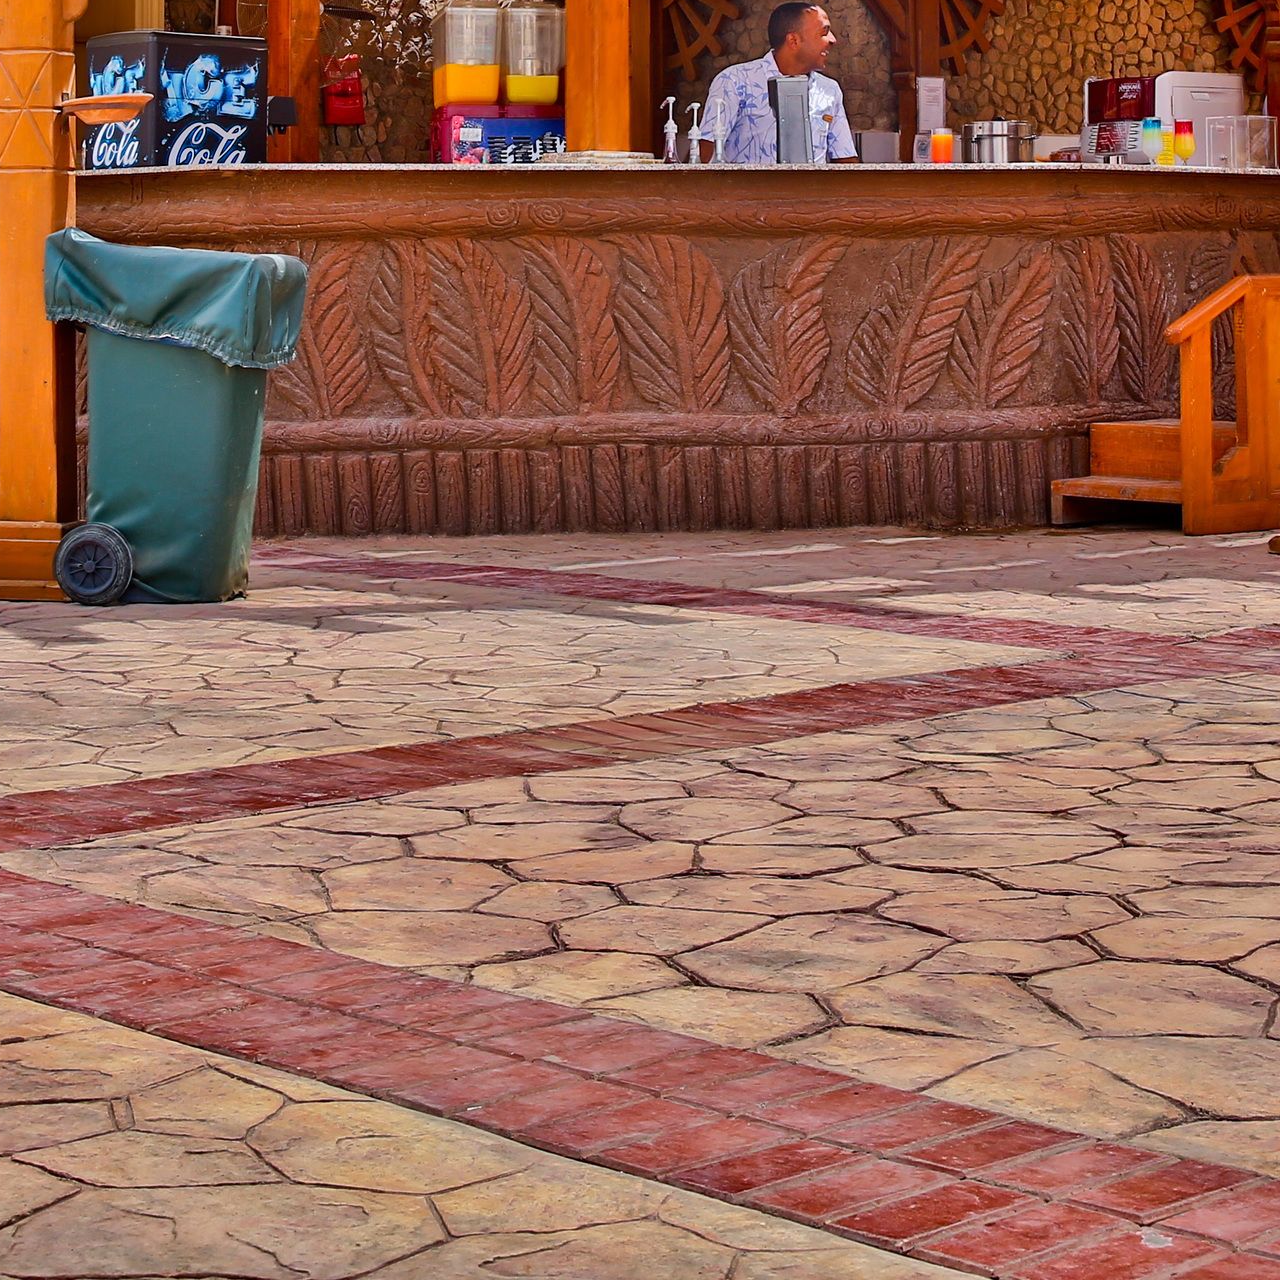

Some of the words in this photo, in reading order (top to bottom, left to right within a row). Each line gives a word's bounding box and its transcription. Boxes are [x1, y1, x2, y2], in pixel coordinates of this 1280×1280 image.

[160, 54, 258, 122] ICE
[92, 119, 140, 166] Cola
[168, 122, 248, 167] Cola
